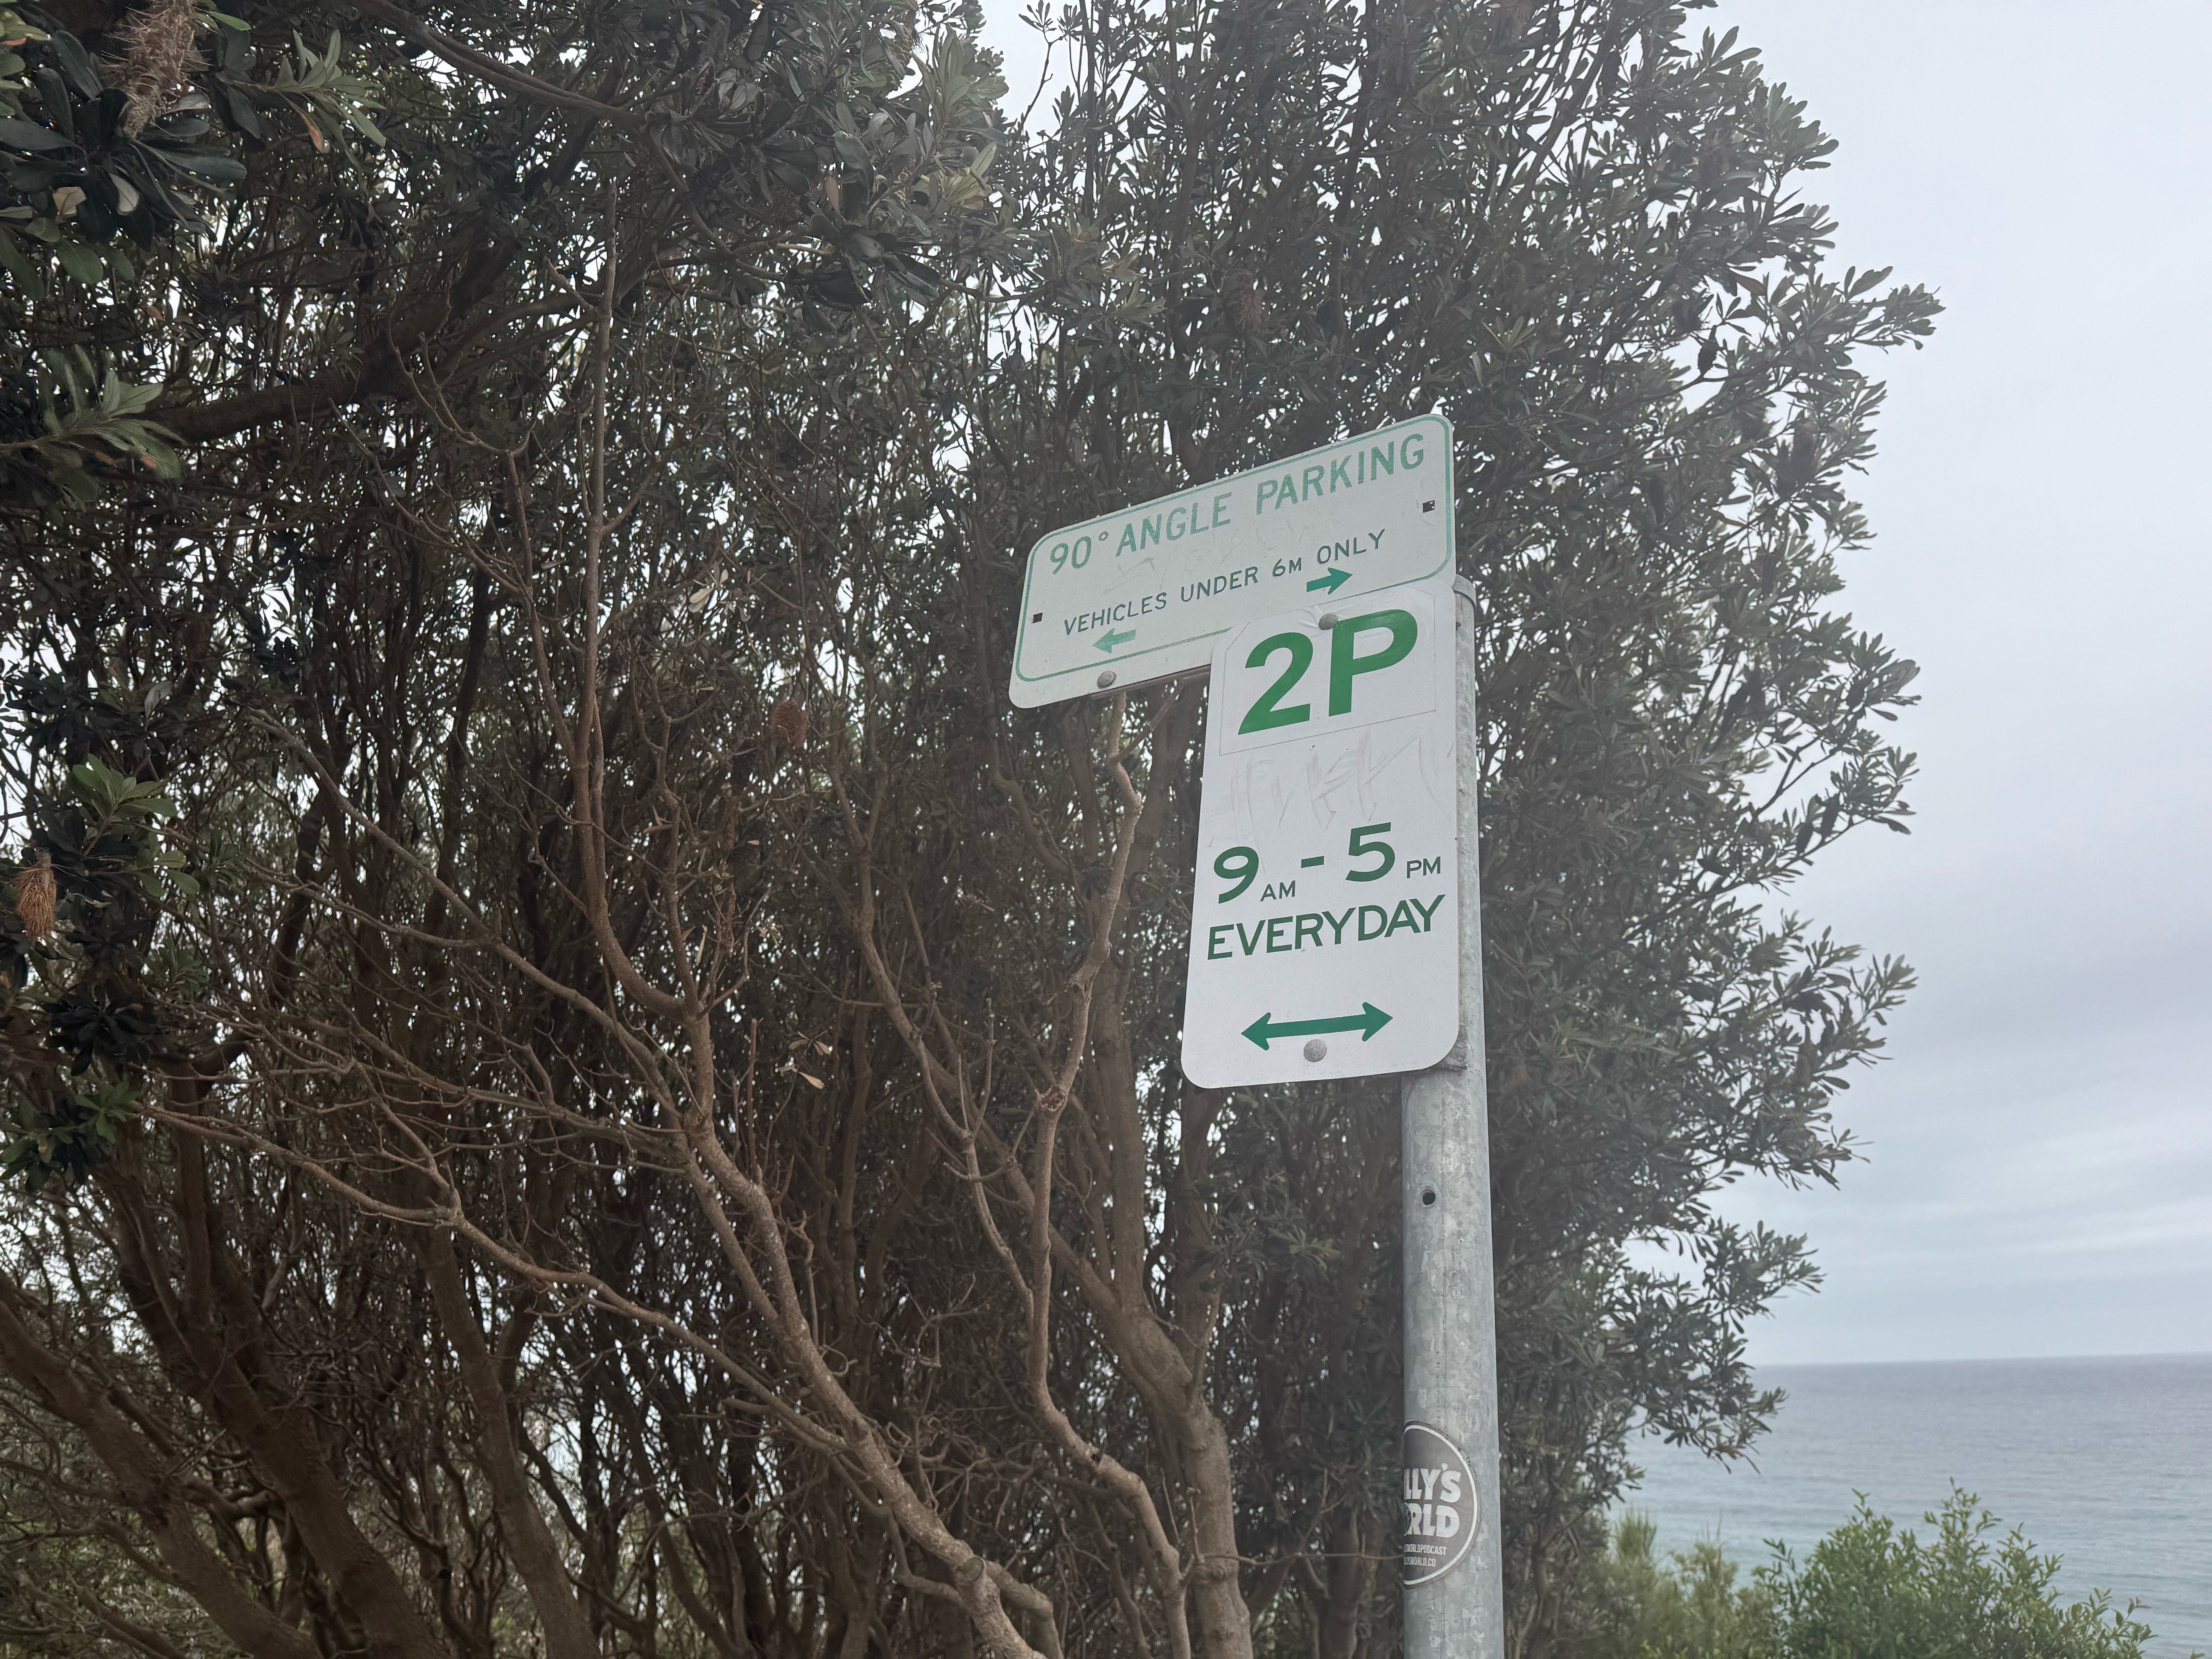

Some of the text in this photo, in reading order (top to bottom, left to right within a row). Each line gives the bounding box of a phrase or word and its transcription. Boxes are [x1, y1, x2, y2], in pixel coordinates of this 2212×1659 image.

[1115, 492, 1232, 557] ANGLE
[1256, 433, 1424, 515] PARKING
[1064, 529, 1385, 635] VEHICLES UNDER 6M ONLY
[1238, 609, 1418, 735] 2P
[1207, 894, 1446, 960] EVERYDAY
